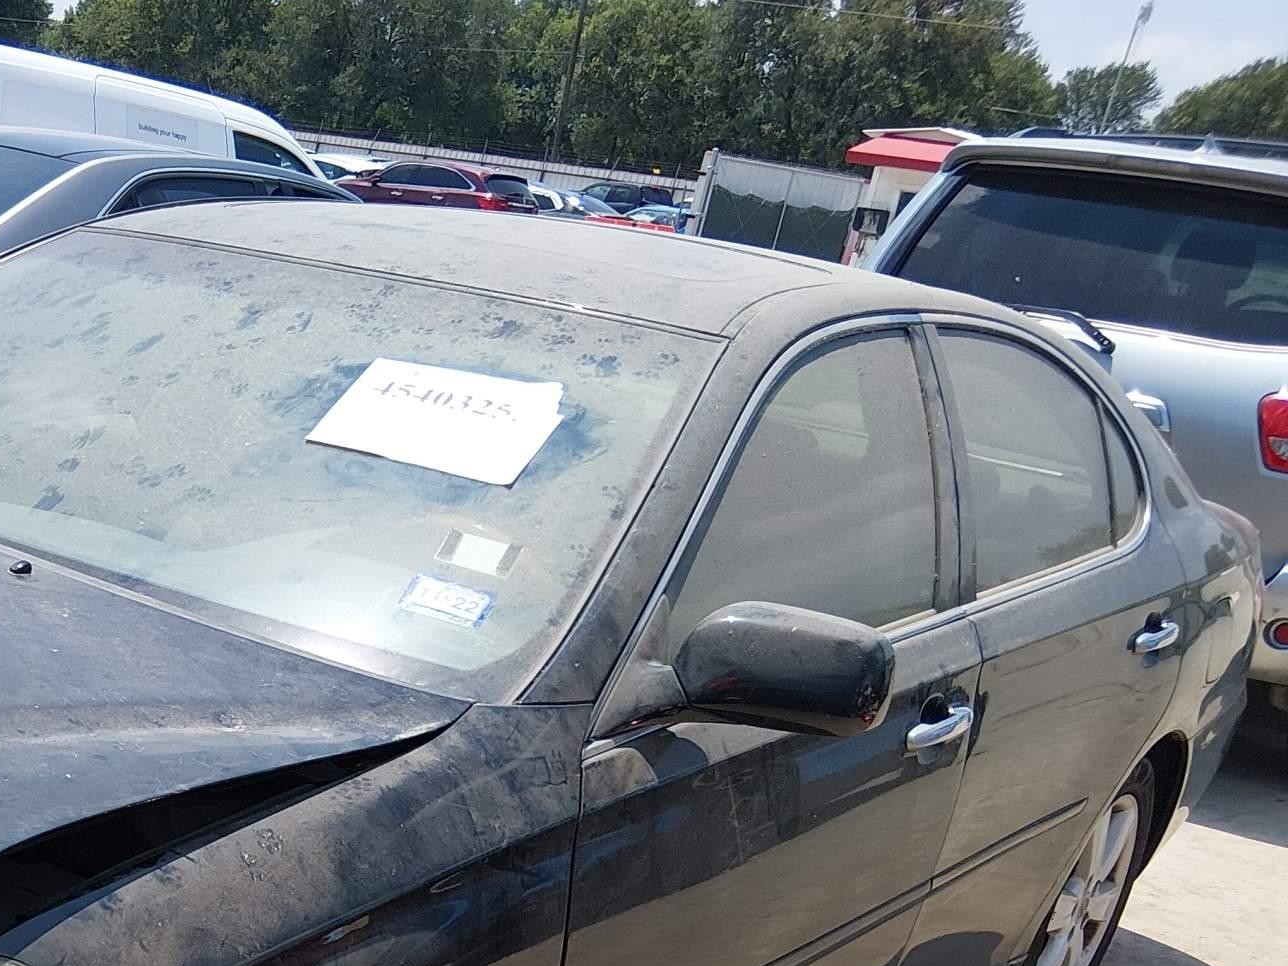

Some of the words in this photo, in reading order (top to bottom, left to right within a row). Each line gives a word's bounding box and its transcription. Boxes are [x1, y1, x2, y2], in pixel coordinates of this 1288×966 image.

[137, 122, 159, 136] building
[159, 129, 172, 137] your
[172, 131, 187, 142] happy
